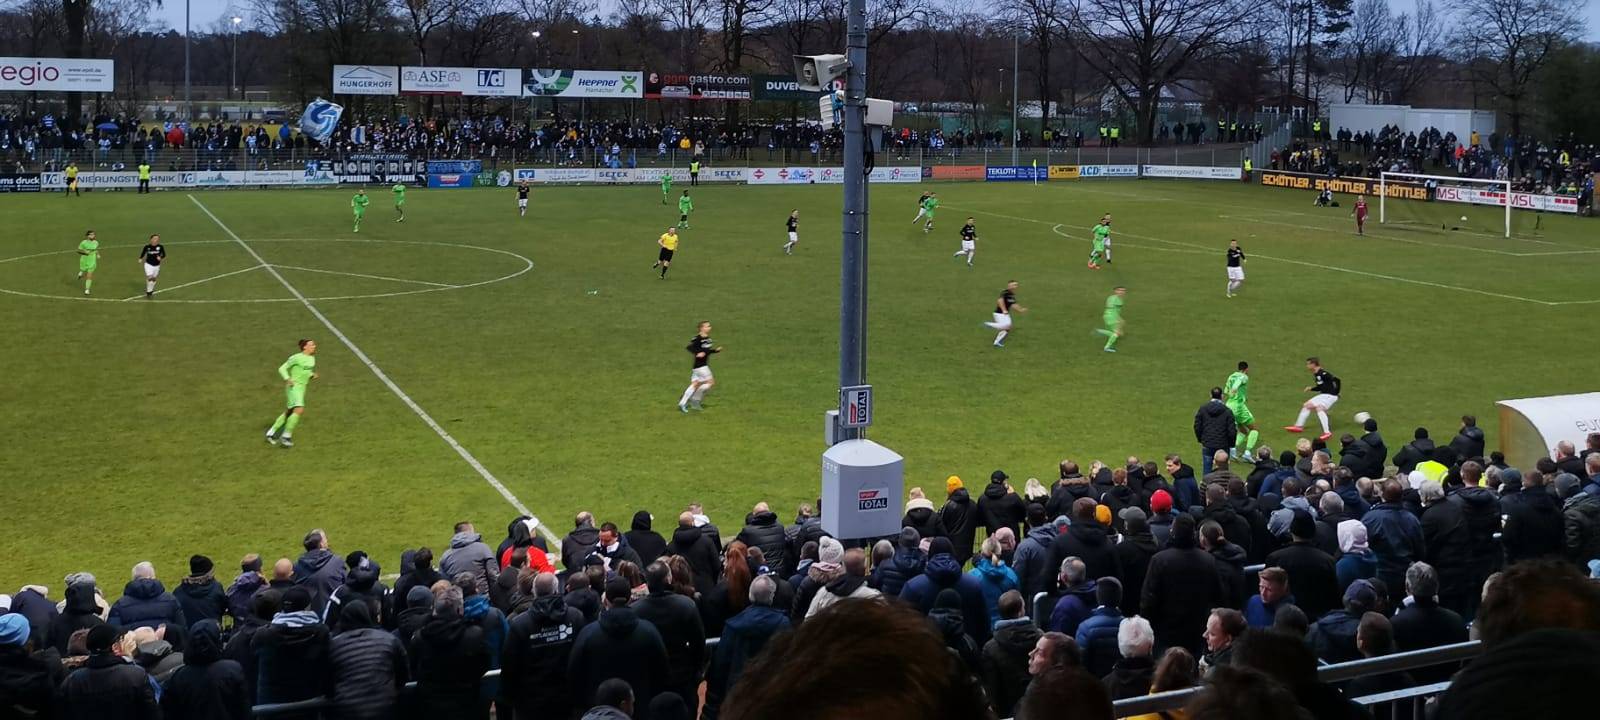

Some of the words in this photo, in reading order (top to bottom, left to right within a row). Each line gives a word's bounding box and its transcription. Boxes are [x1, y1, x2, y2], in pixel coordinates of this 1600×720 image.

[0, 61, 59, 86] egio
[418, 70, 447, 82] ASF
[663, 73, 750, 85] ggmgastro.com
[339, 80, 393, 88] HUNGERHOFF
[333, 161, 425, 174] KOHORTE
[987, 167, 1017, 175] TEKLOTH
[15, 176, 40, 185] druck
[63, 175, 175, 184] SNIERUNGSTHNIK
[1372, 183, 1427, 200] SHÖTTLER
[1437, 187, 1462, 200] MSL
[1510, 193, 1536, 207] MSL
[858, 392, 867, 421] TOTAL
[860, 499, 887, 510] TOTAL
